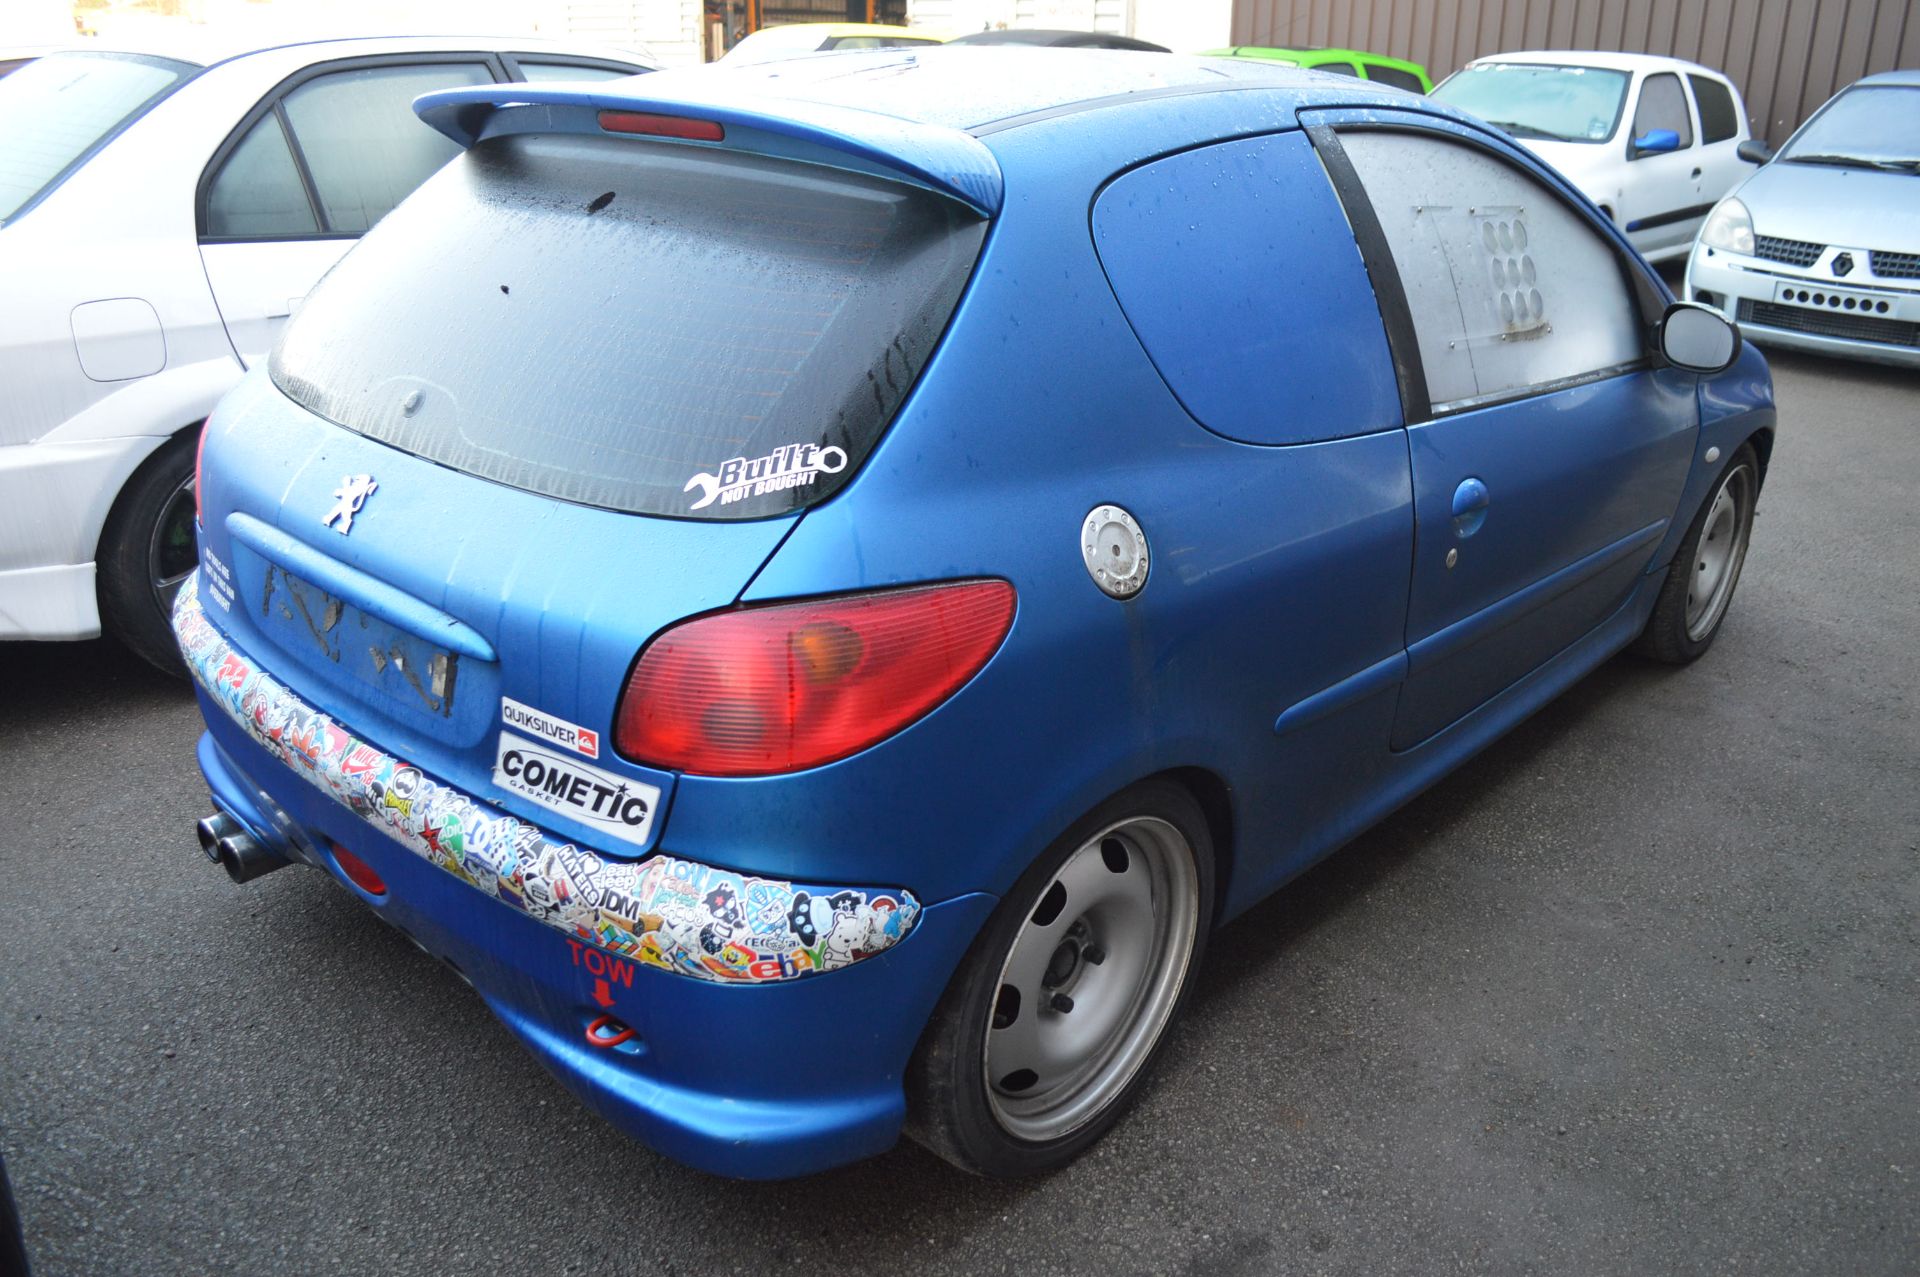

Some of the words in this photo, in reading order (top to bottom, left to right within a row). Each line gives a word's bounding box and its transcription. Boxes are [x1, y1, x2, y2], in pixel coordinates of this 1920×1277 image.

[719, 443, 820, 488] Built
[721, 484, 752, 505] NOT
[754, 471, 819, 496] BOUGHT
[504, 705, 576, 745] QUIKSILVER
[353, 746, 378, 766] NIKE
[509, 779, 561, 806] GASKET
[558, 849, 600, 907] HATERS
[604, 864, 635, 877] eat
[600, 889, 640, 921] JDM
[566, 939, 635, 989] TOW
